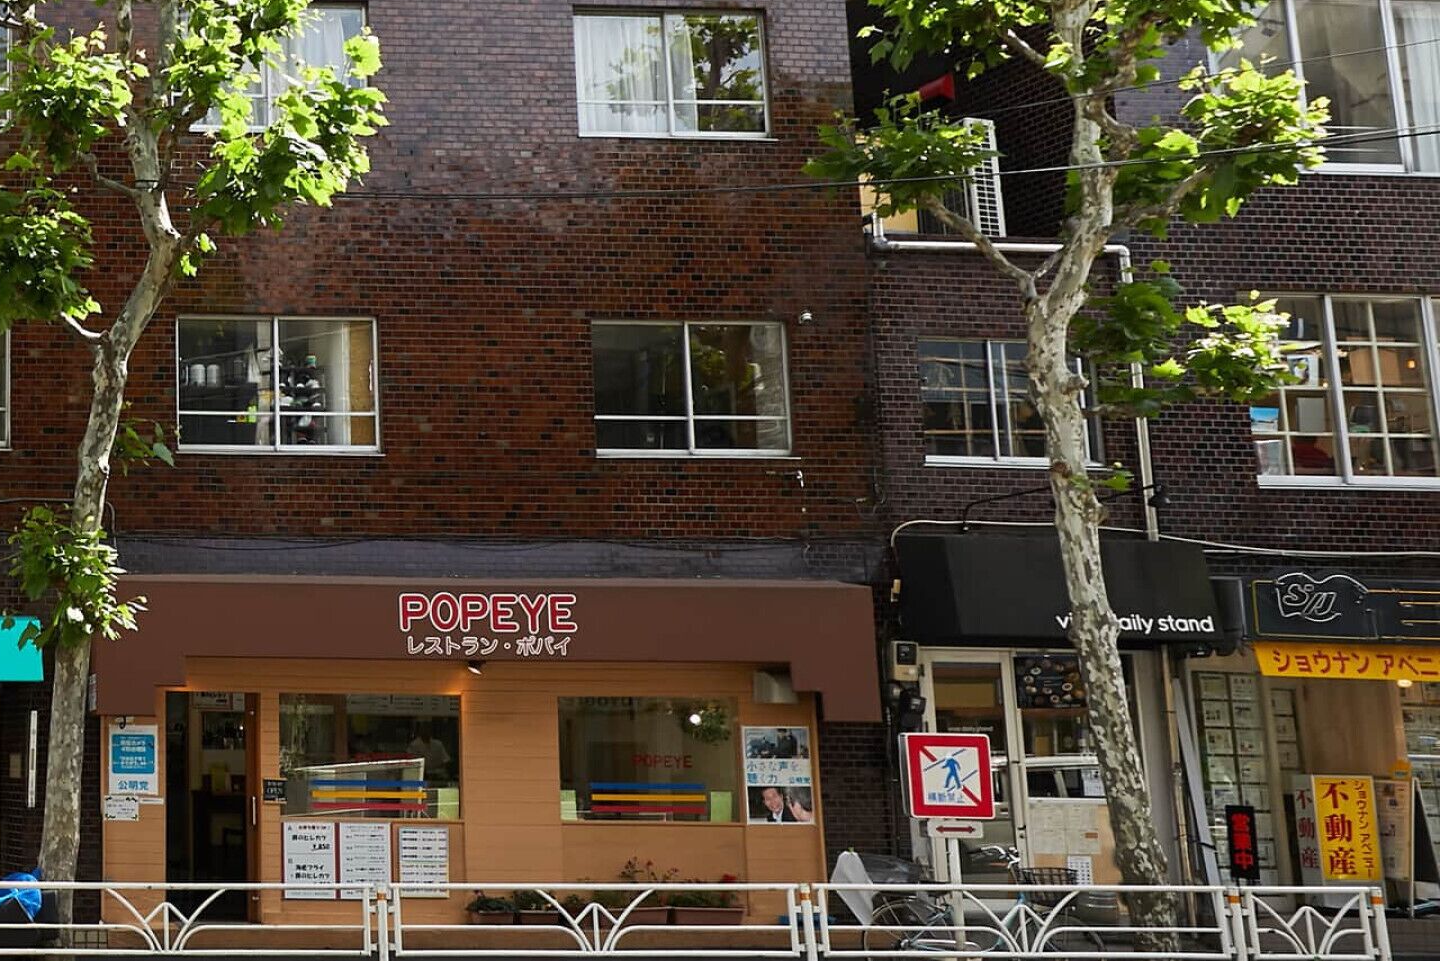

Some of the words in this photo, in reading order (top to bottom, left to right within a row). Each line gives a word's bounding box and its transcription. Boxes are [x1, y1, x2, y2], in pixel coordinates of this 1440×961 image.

[399, 592, 578, 634] POPEYE
[1118, 613, 1154, 635] aily
[1158, 615, 1215, 633] stand
[1273, 648, 1370, 674] ショウナン
[631, 754, 693, 769] POPEYE
[1352, 780, 1370, 830] ショウナン
[1321, 781, 1358, 876] 不動産
[1360, 833, 1376, 878] アベニュー
